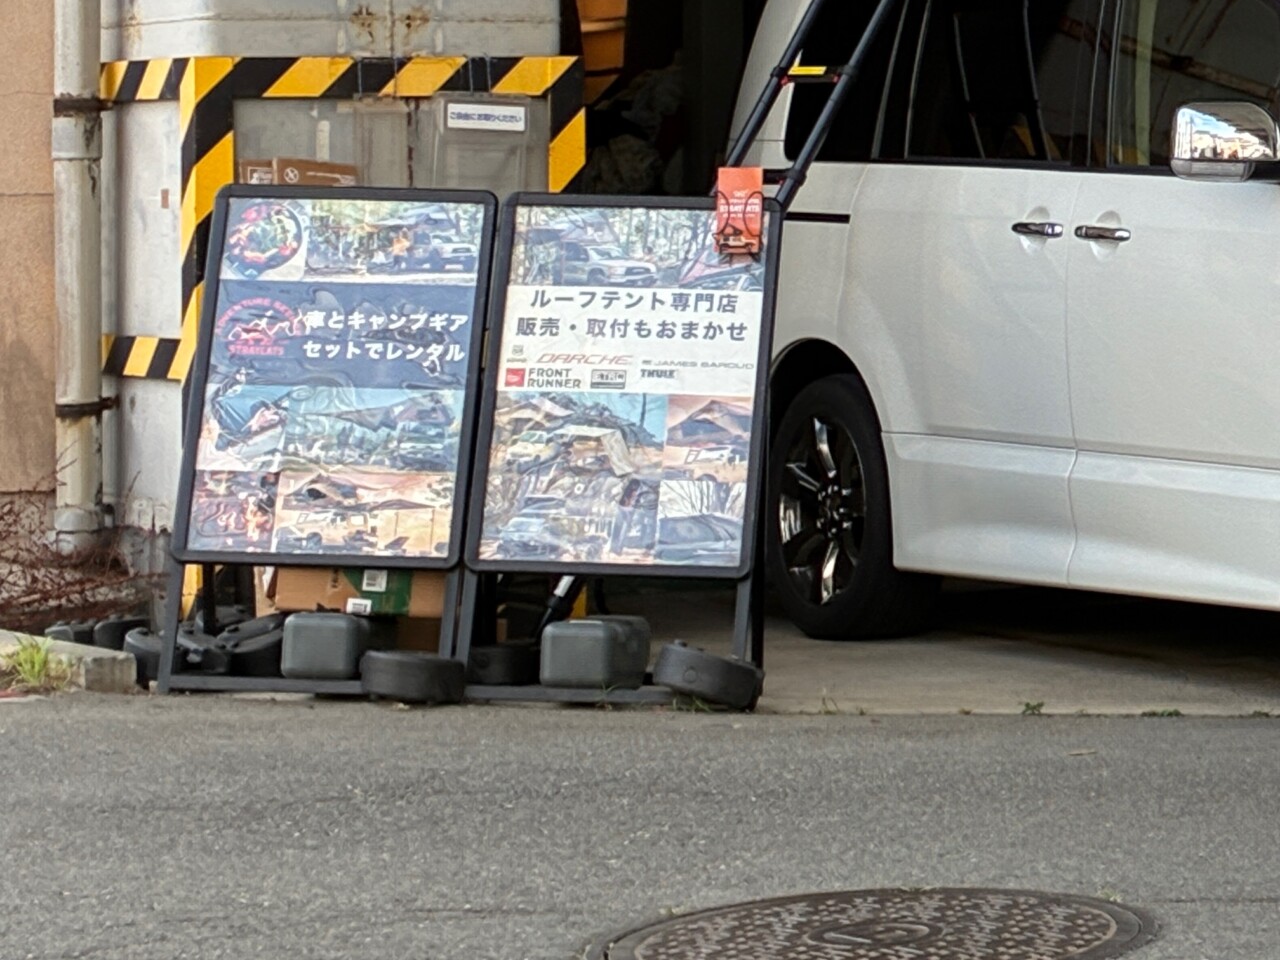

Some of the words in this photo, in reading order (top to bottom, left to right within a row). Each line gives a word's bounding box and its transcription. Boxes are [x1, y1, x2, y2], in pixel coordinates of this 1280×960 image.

[530, 289, 739, 314] ルーフテント専門店
[515, 317, 749, 342] 販売・取付もおまかせ
[303, 340, 466, 362] セットでレンタル
[536, 353, 633, 366] DARCHE
[528, 368, 573, 378] FRONT
[640, 369, 678, 379] THULE
[527, 378, 582, 389] RUNNER
